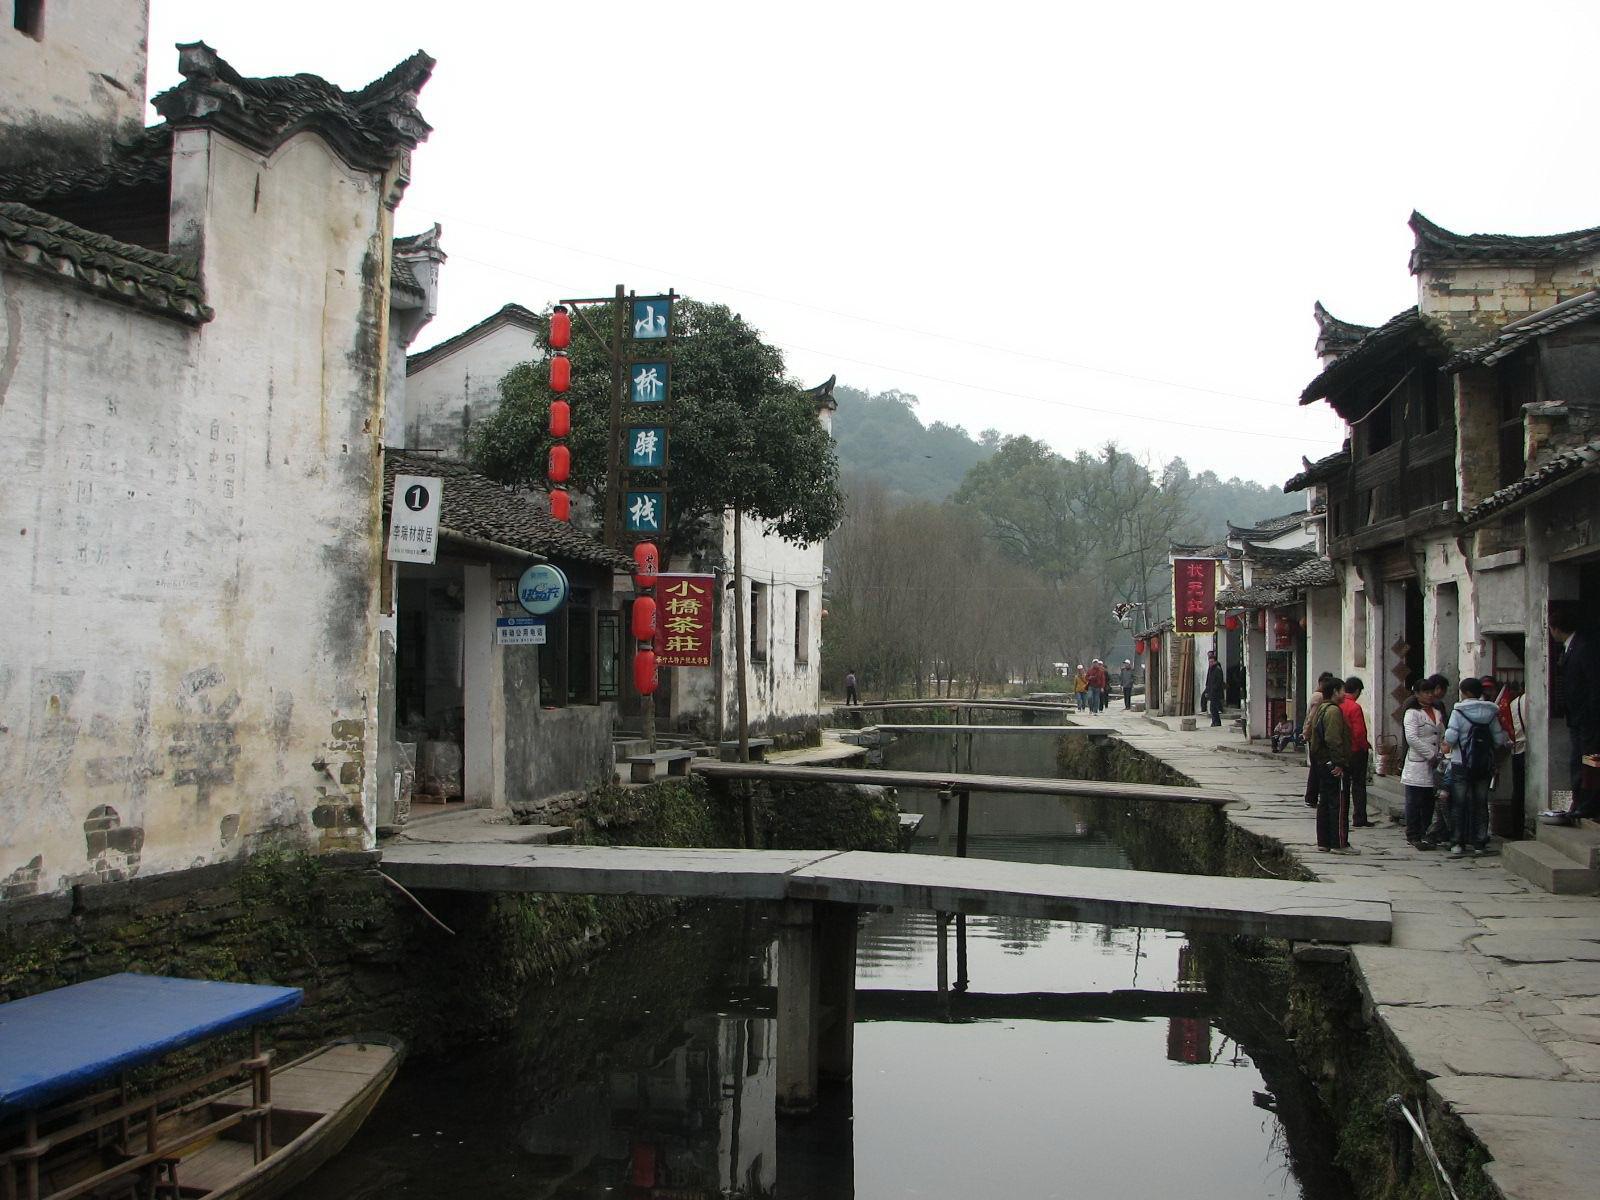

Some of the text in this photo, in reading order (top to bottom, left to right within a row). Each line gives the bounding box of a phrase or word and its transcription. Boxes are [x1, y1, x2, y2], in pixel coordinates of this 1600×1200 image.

[412, 487, 421, 508] 1
[664, 580, 705, 651] 小橋茶莊
